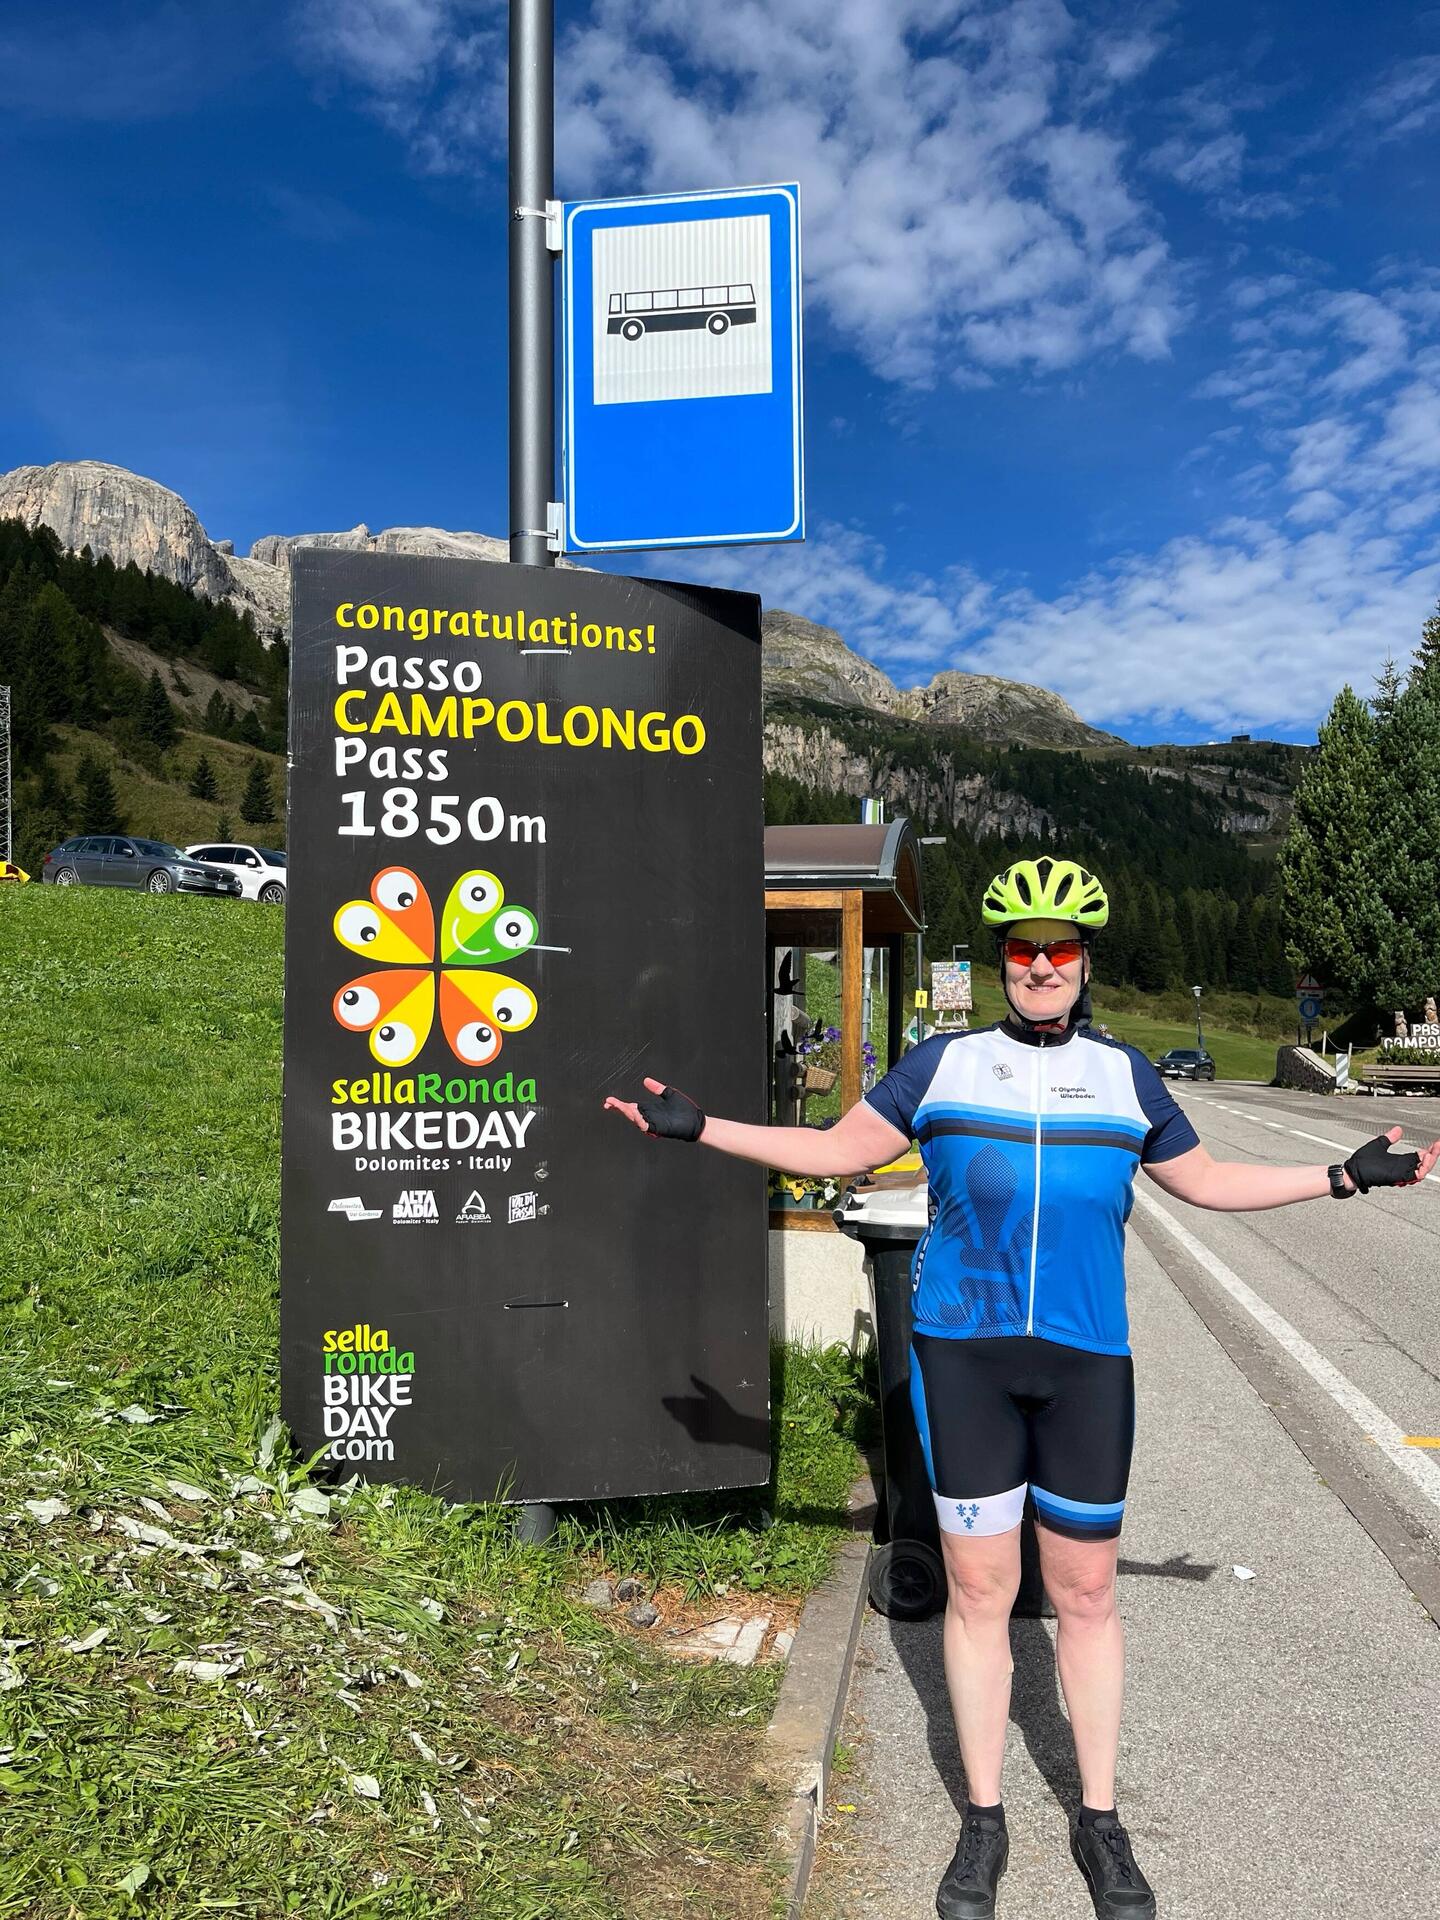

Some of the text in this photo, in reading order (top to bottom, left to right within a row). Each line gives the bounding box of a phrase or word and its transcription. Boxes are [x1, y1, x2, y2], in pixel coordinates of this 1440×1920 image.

[335, 602, 656, 654] congratulations!
[335, 644, 483, 693] Passo
[334, 689, 707, 755] CAMPOLONGO
[335, 736, 449, 782] Pass
[331, 1072, 537, 1104] sellaRonda
[331, 1111, 537, 1151] BIKEDAY
[355, 1155, 512, 1172] Dolomites Italy
[392, 1203, 439, 1218] BADIA
[398, 1190, 436, 1204] ALTA
[323, 1324, 389, 1352] sella
[324, 1345, 416, 1374] ronda
[323, 1374, 413, 1406] BIKE
[323, 1406, 397, 1437] DAY
[323, 1439, 395, 1461] .com
